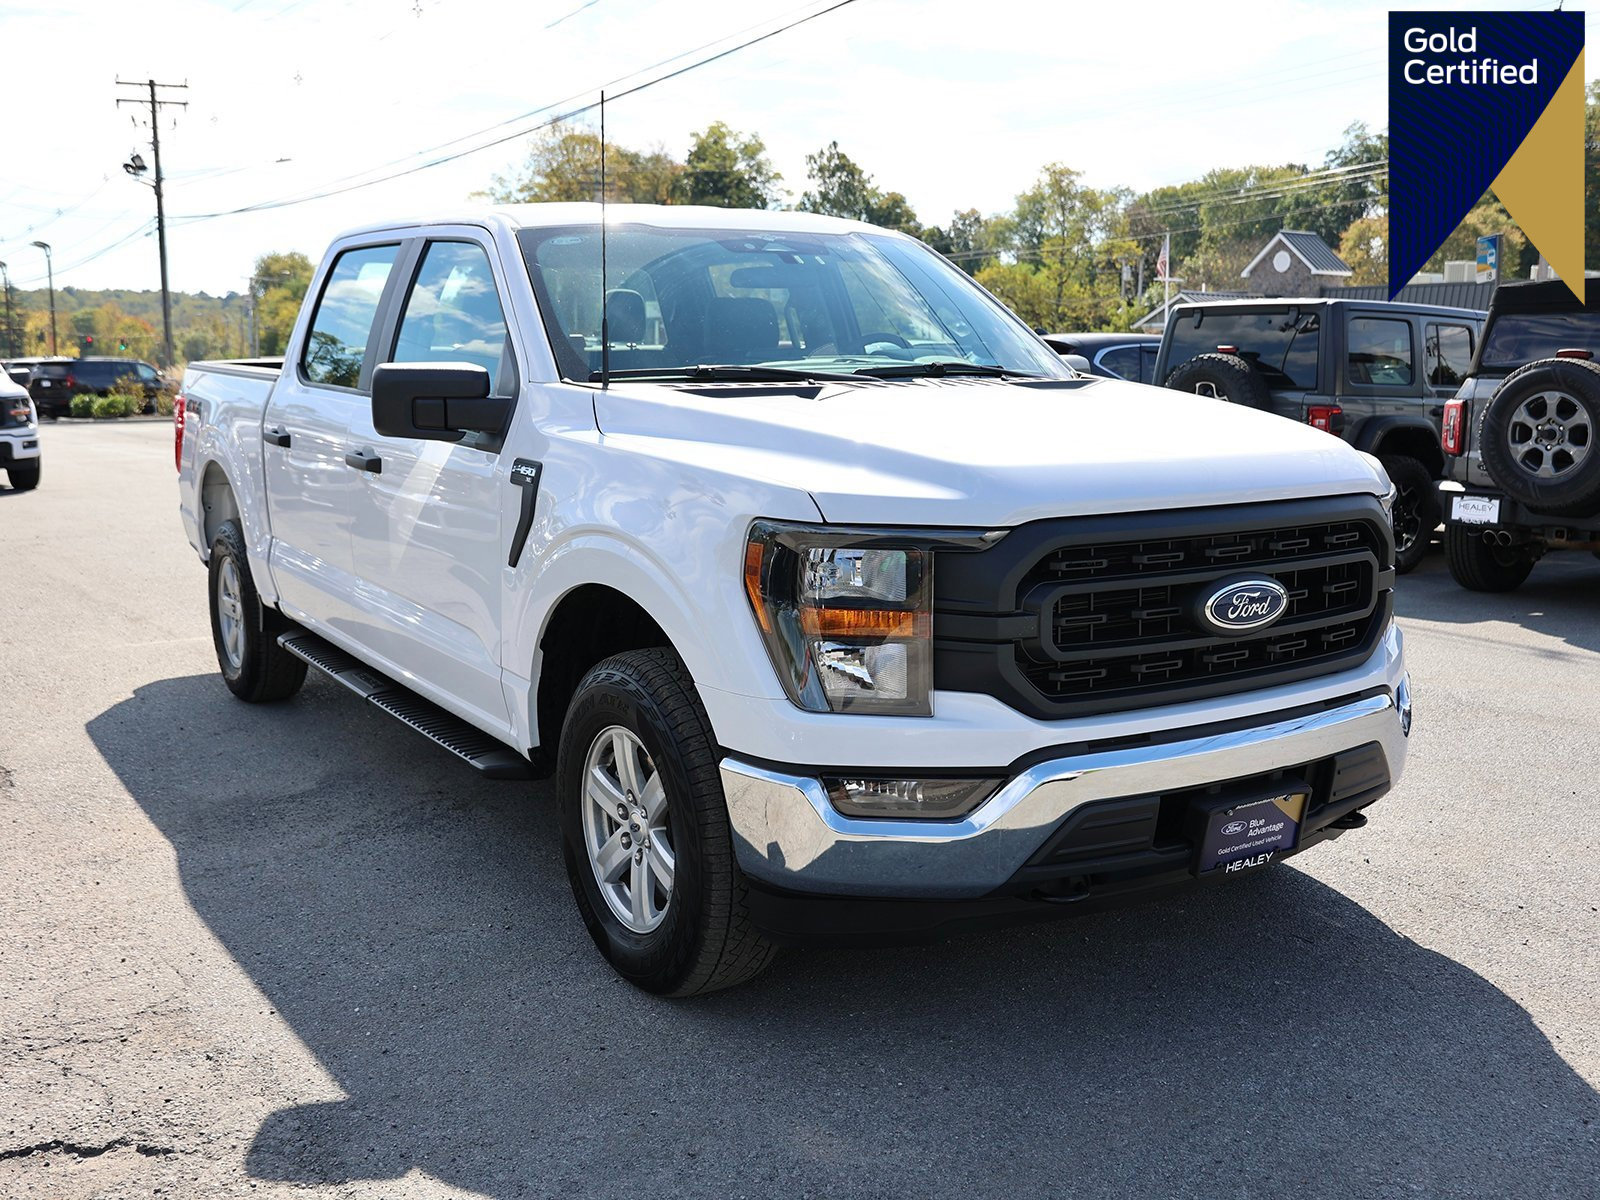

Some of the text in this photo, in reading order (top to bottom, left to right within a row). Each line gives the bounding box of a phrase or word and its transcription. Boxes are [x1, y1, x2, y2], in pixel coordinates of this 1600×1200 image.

[1459, 503, 1493, 512] HEALEY
[1227, 591, 1272, 620] Ford
[1226, 819, 1265, 833] Ford Blue
[1247, 822, 1284, 837] Advantage
[1217, 834, 1282, 855] Gold Certified Used Vehicle
[1225, 851, 1274, 874] HEALEY
